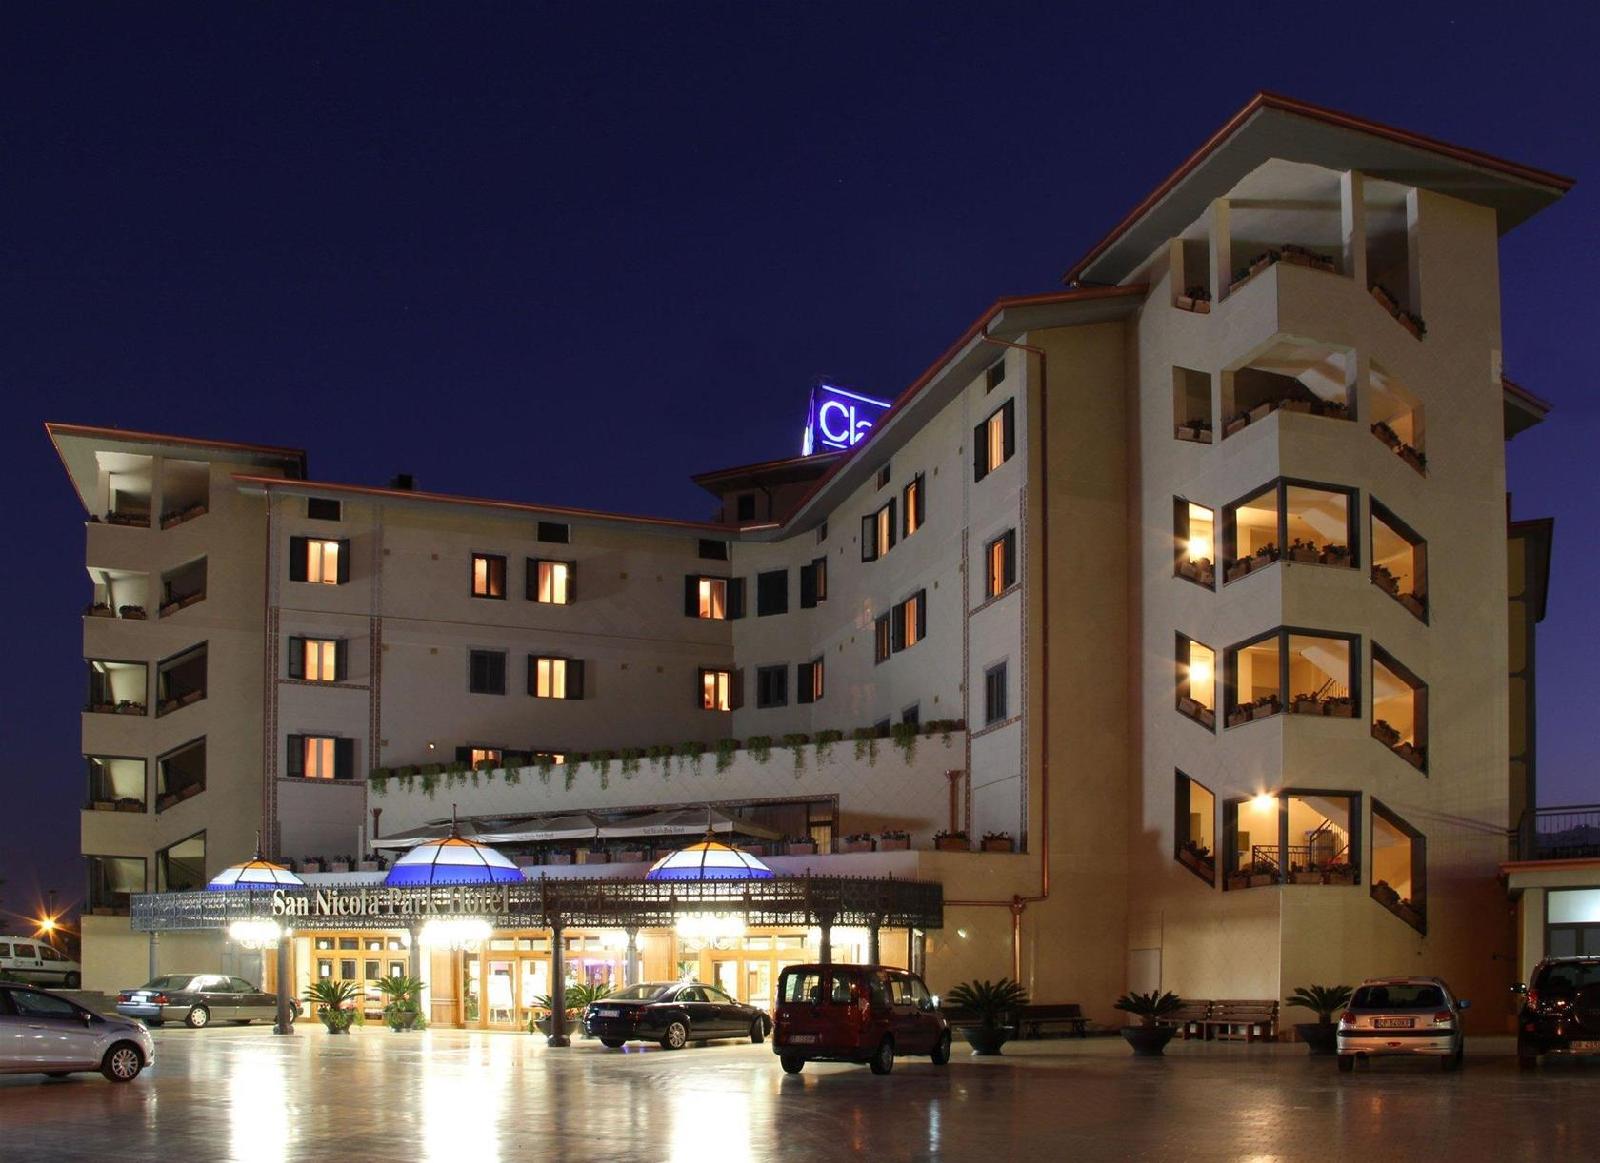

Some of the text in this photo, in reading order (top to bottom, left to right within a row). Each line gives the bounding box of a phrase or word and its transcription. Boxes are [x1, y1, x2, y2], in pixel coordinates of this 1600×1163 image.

[273, 885, 509, 916] San Nicola Park Hotel
